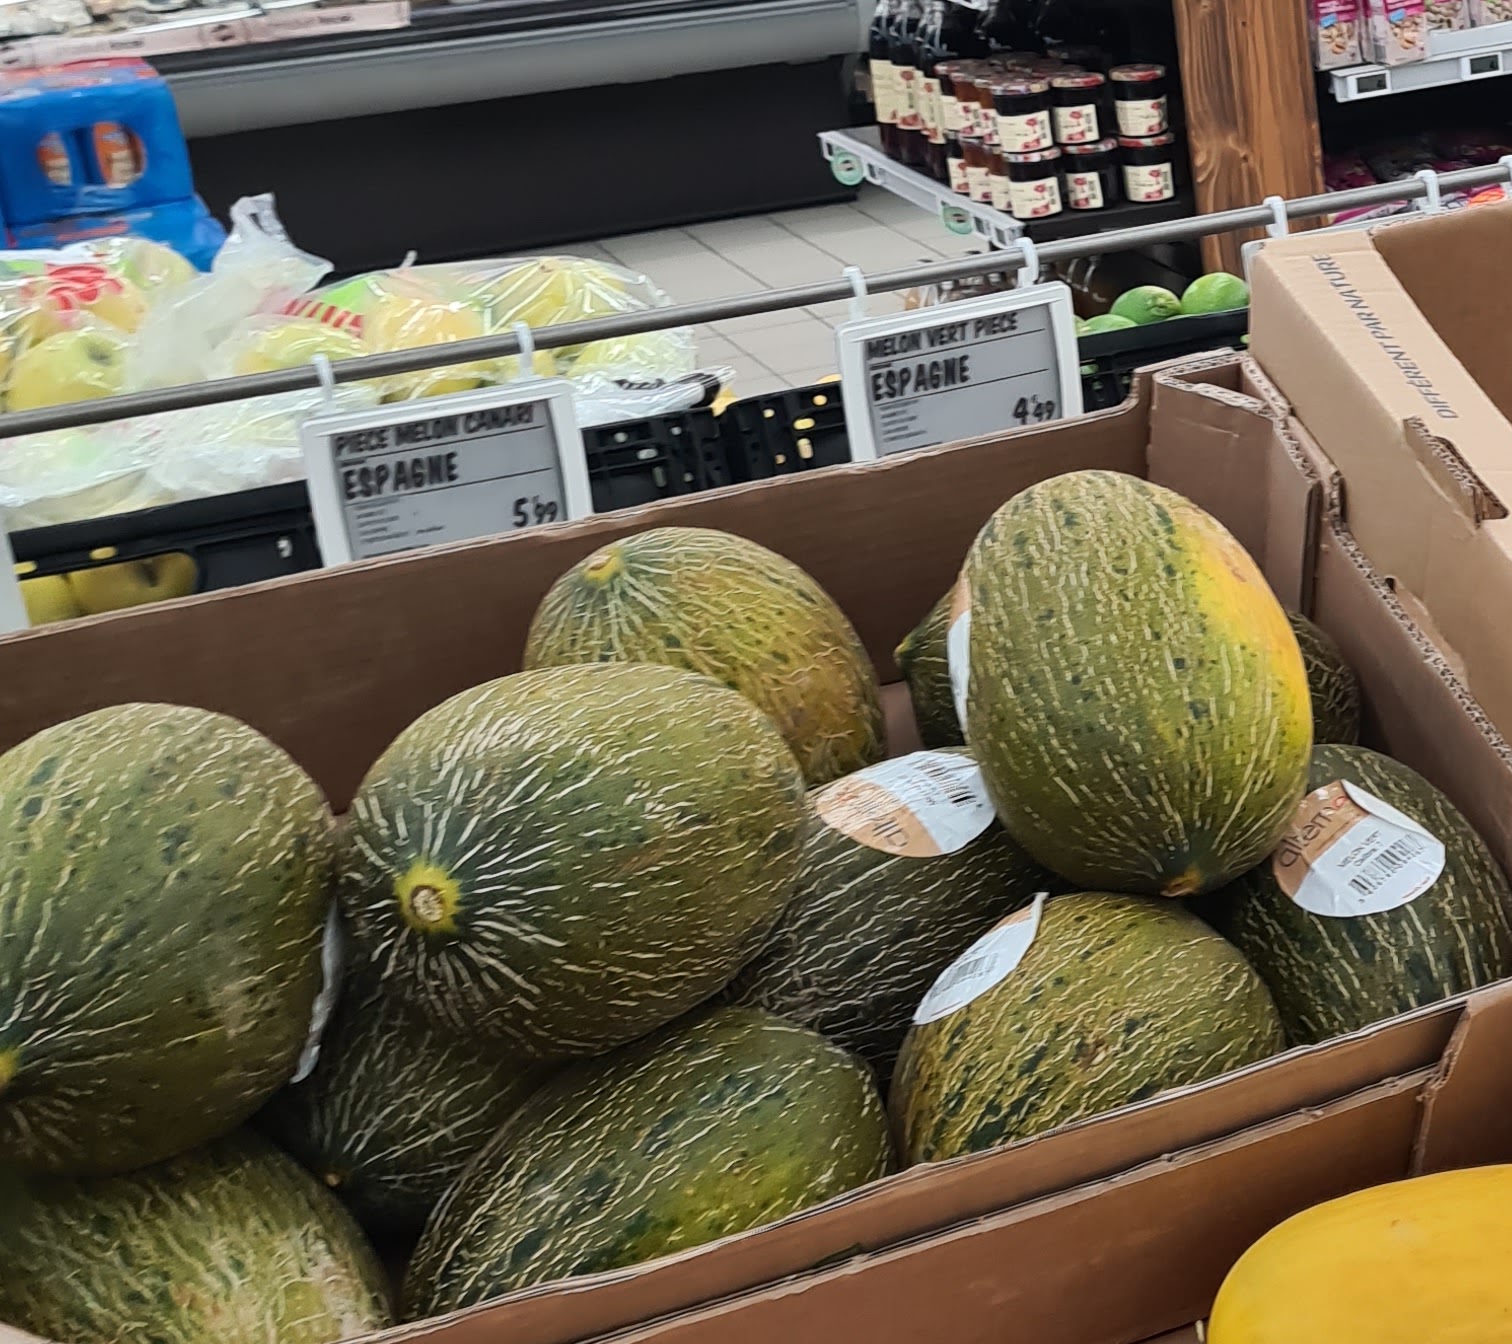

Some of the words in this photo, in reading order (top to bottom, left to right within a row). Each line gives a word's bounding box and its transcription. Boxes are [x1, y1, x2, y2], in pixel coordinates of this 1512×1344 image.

[926, 322, 969, 348] VERT
[974, 311, 1019, 339] PIECE
[1356, 311, 1395, 340] PAR
[871, 354, 971, 403] ESPAGNE
[1378, 341, 1460, 420] DIFFÉRENT
[342, 451, 460, 502] ESPAGNE
